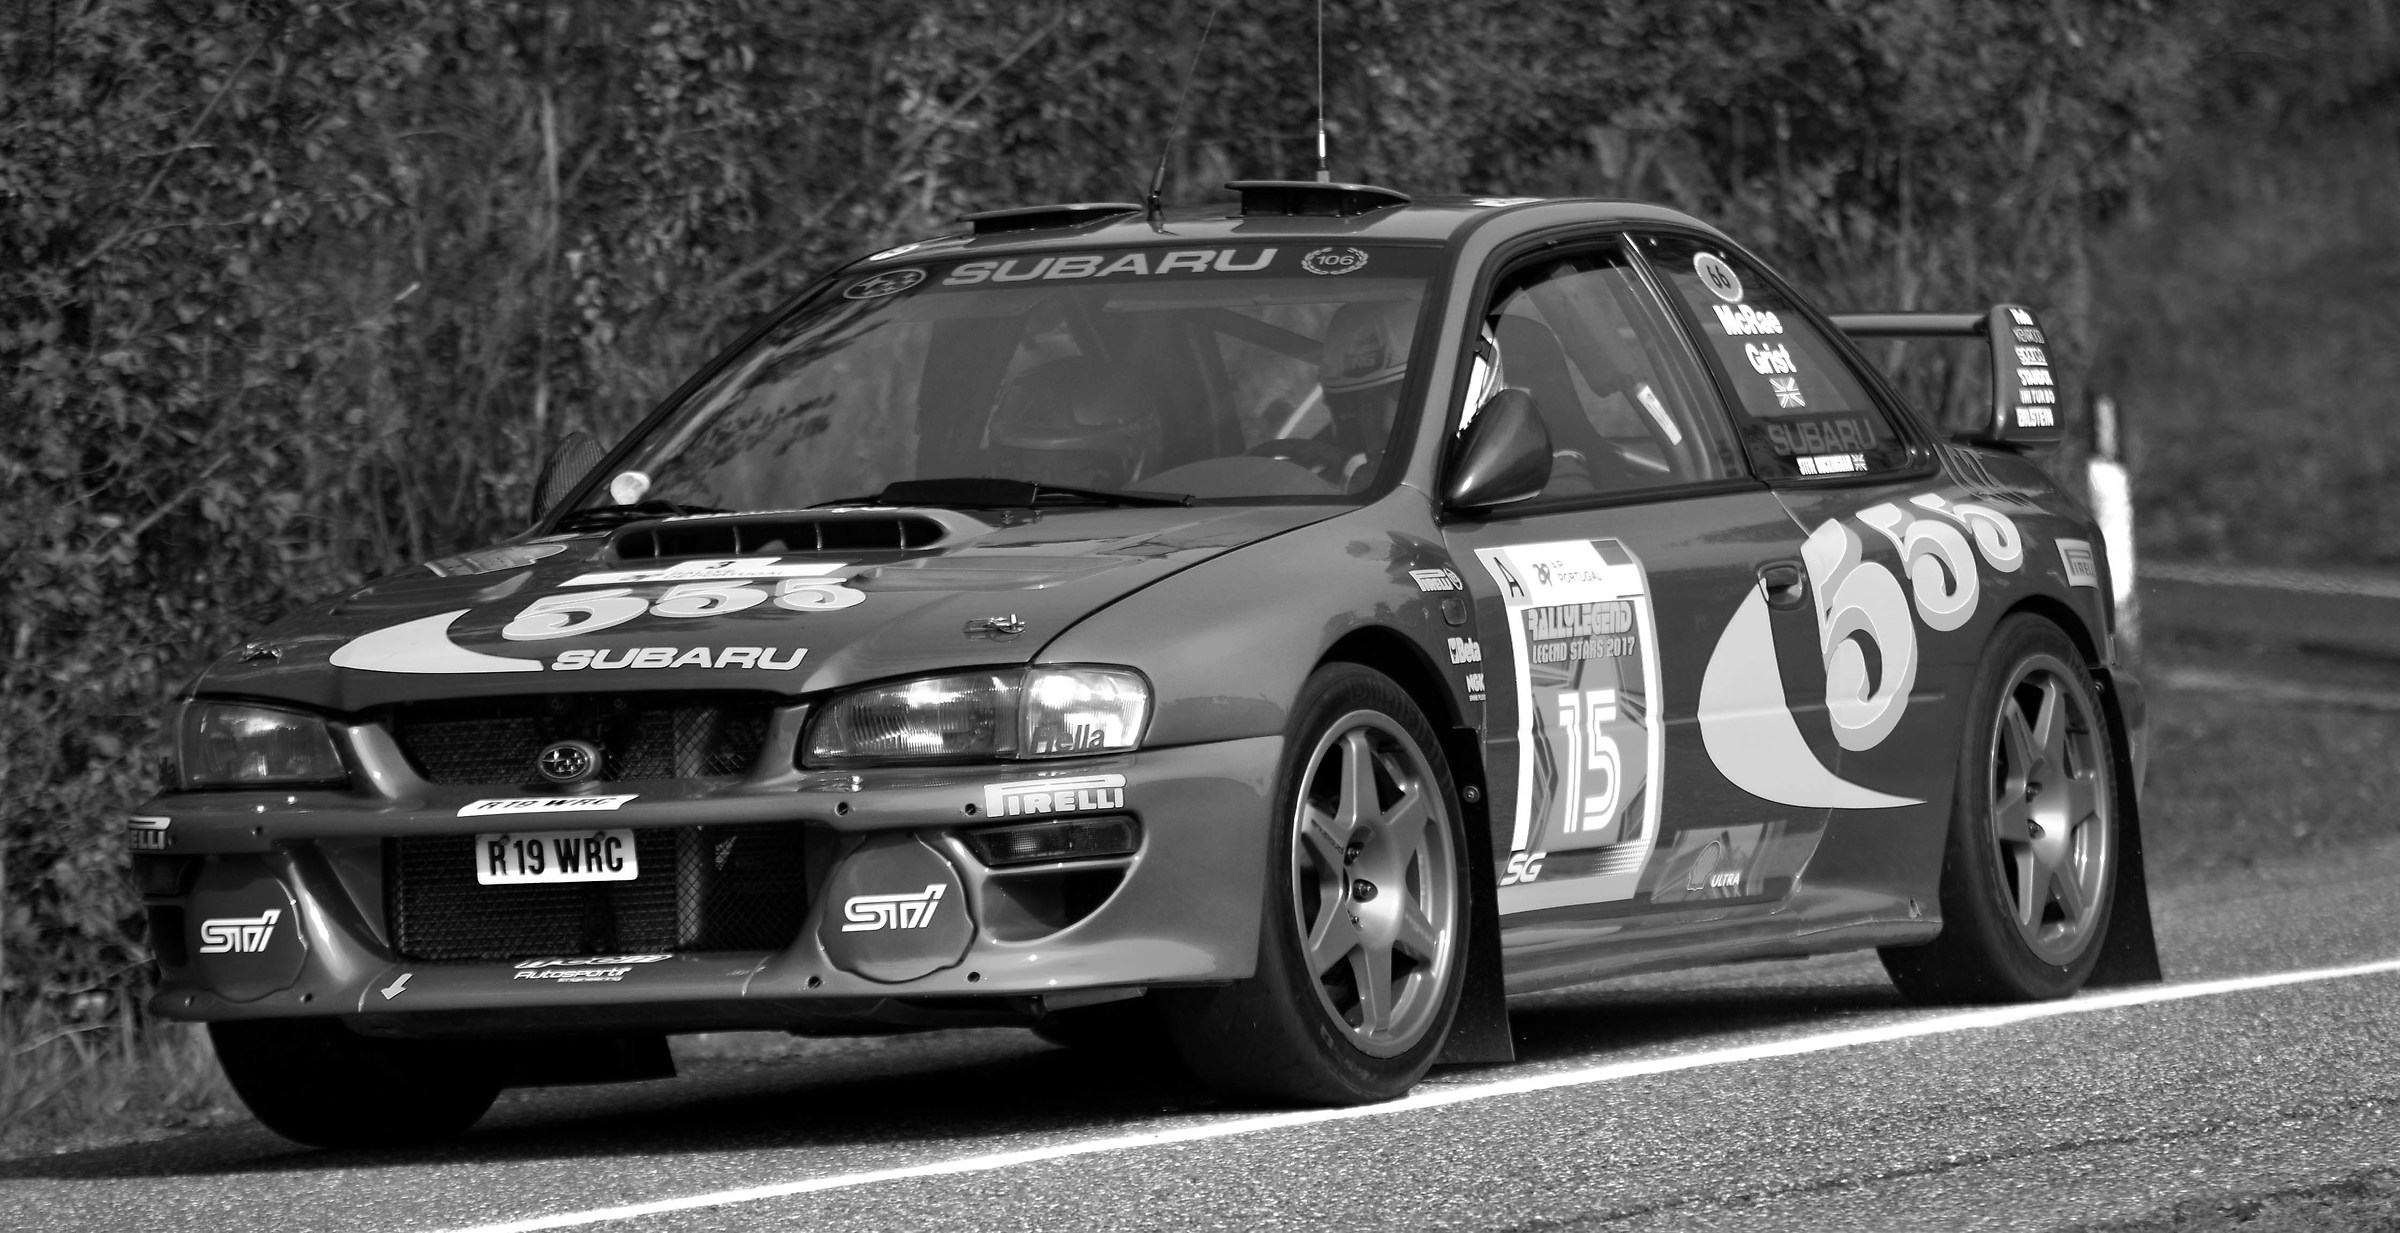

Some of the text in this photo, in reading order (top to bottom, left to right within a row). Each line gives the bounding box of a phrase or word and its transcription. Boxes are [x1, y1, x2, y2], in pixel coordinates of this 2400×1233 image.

[942, 248, 1279, 286] SUBARU
[1317, 253, 1355, 268] 106
[1712, 304, 1784, 337] McRae
[1744, 343, 1798, 375] Grist
[1767, 418, 1877, 457] SUBARU
[502, 577, 867, 641] 555
[552, 647, 809, 671] SUBARU
[1532, 636, 1636, 664] LEGEND STARS 2017
[1466, 673, 1486, 693] NGK
[1031, 723, 1106, 754] Hella
[1558, 688, 1622, 834] 15
[543, 797, 618, 808] WRC
[984, 773, 1127, 818] PIRELLI
[552, 836, 623, 874] WRC
[1500, 852, 1547, 886] SG
[1710, 872, 1741, 888] ULTRA
